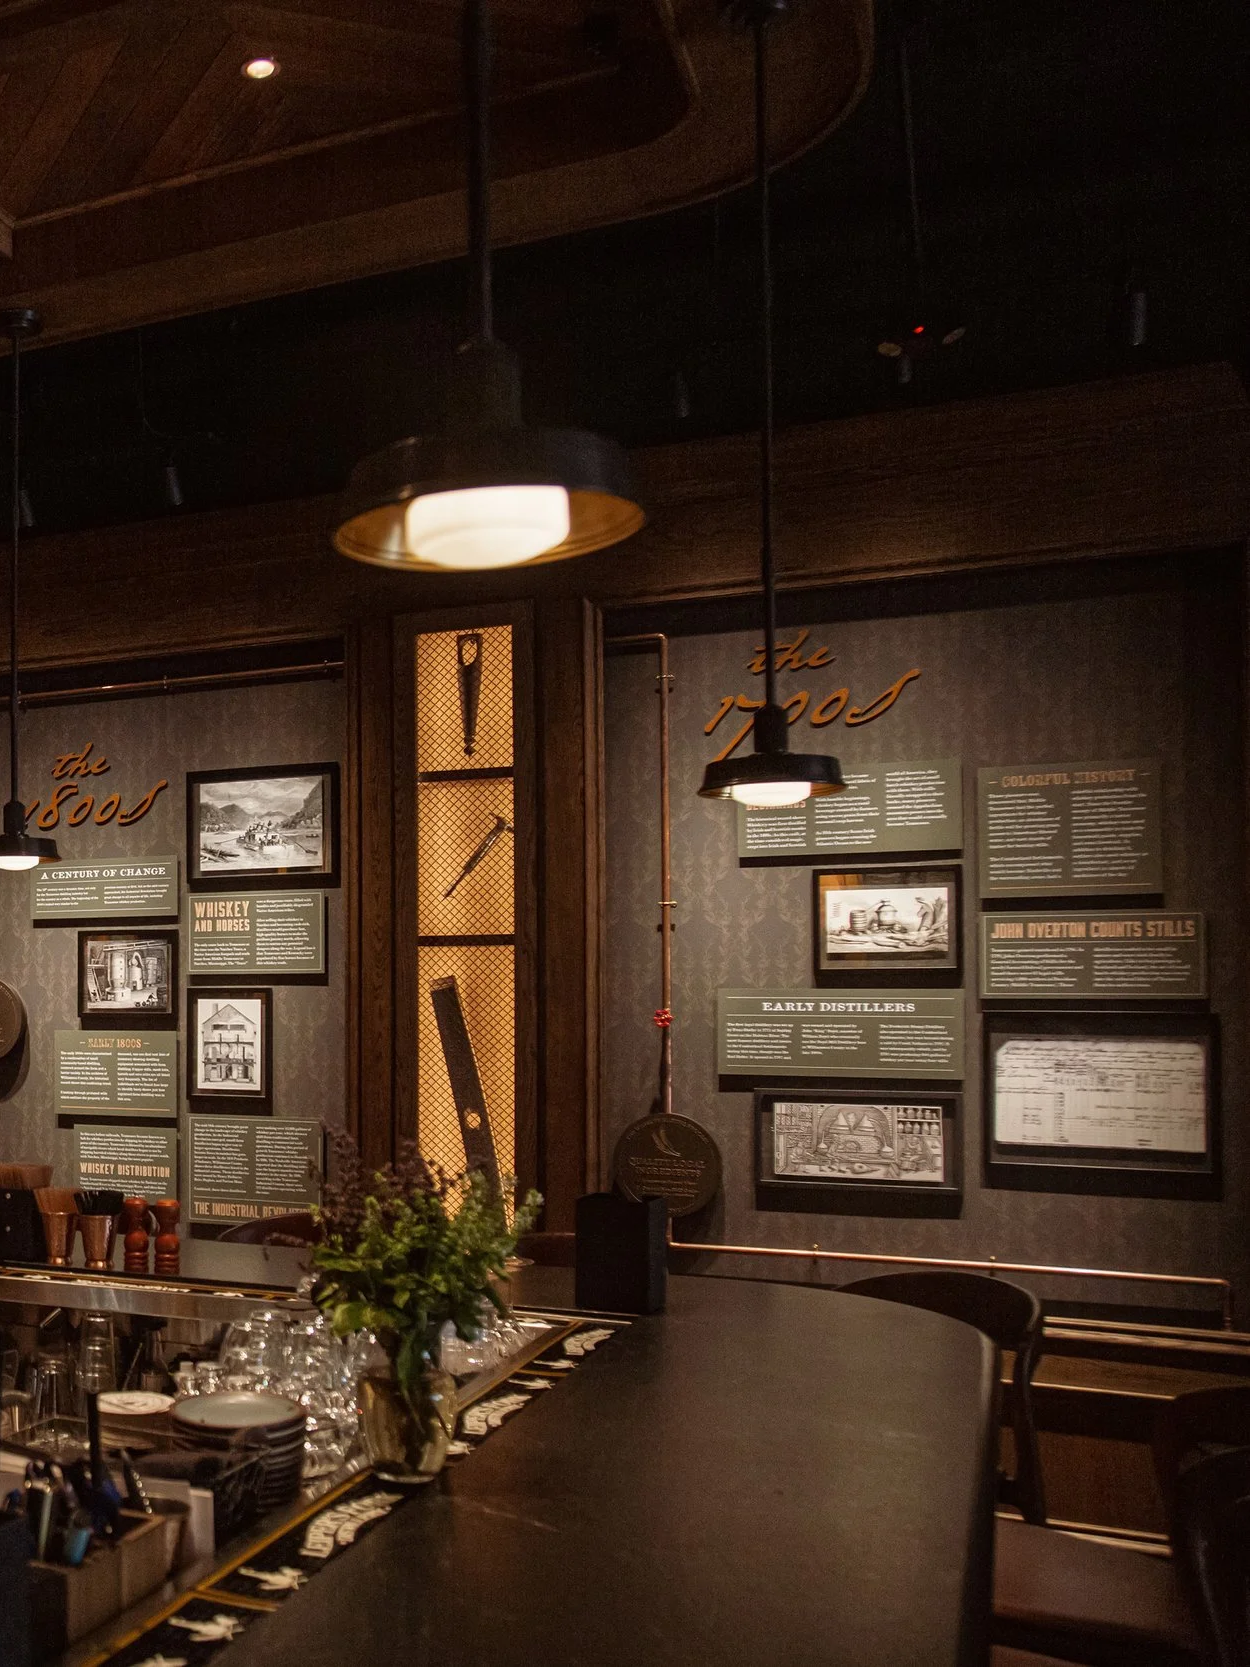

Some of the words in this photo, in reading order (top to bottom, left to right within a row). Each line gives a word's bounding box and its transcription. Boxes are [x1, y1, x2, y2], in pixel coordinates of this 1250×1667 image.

[748, 628, 837, 673] the
[52, 742, 110, 779] the
[1002, 772, 1071, 788] COLORFUL
[41, 872, 49, 880] A
[51, 869, 100, 880] CENTURY
[102, 868, 118, 878] OF
[120, 867, 166, 877] CHANGE
[194, 900, 250, 918] WHISKEY
[194, 919, 213, 932] AND
[216, 918, 250, 932] HORSES
[990, 922, 1024, 939] JOHN
[1027, 921, 1086, 938] OVERTON
[1089, 920, 1143, 938] COUNTS
[1146, 919, 1195, 937] STILLS
[762, 1001, 815, 1012] EARLY
[819, 1001, 916, 1013] DISTILLERS
[87, 1038, 115, 1049] EARLY
[79, 1161, 115, 1175] WHISKEY
[117, 1164, 171, 1178] DISTRIBUTION
[193, 1201, 210, 1215] THE
[212, 1202, 261, 1218] INDUSTRIAL
